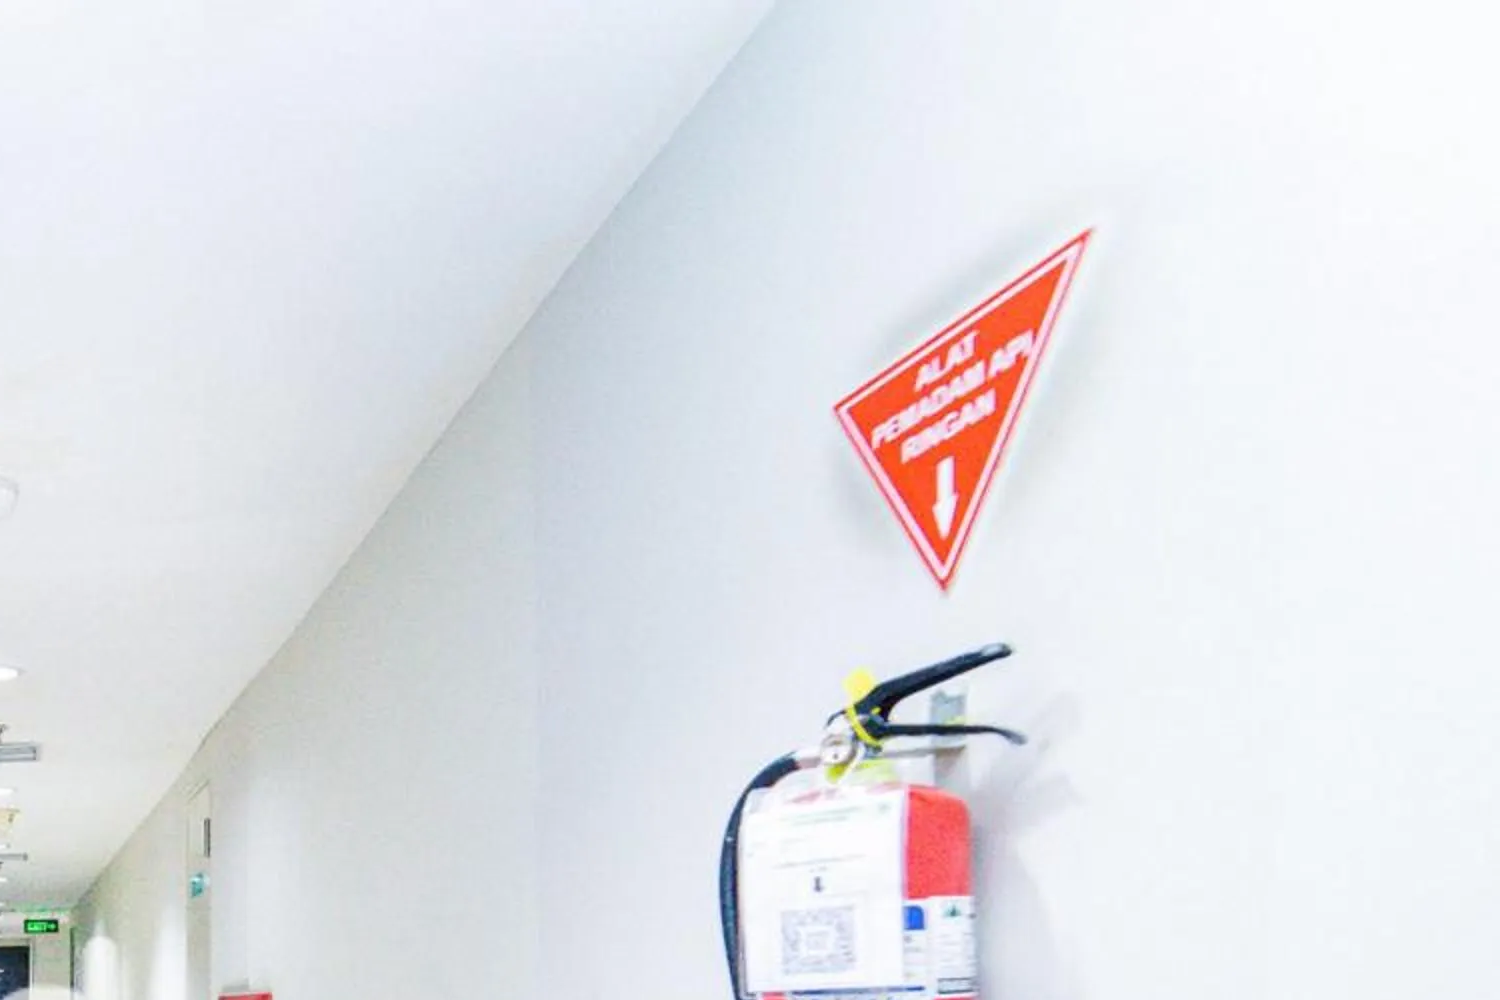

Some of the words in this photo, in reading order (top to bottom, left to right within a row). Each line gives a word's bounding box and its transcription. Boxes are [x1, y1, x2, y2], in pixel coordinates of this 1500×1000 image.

[871, 360, 986, 449] PEMADAM
[987, 329, 1034, 379] API
[914, 330, 978, 392] ALAT
[901, 387, 996, 464] RINGAN
